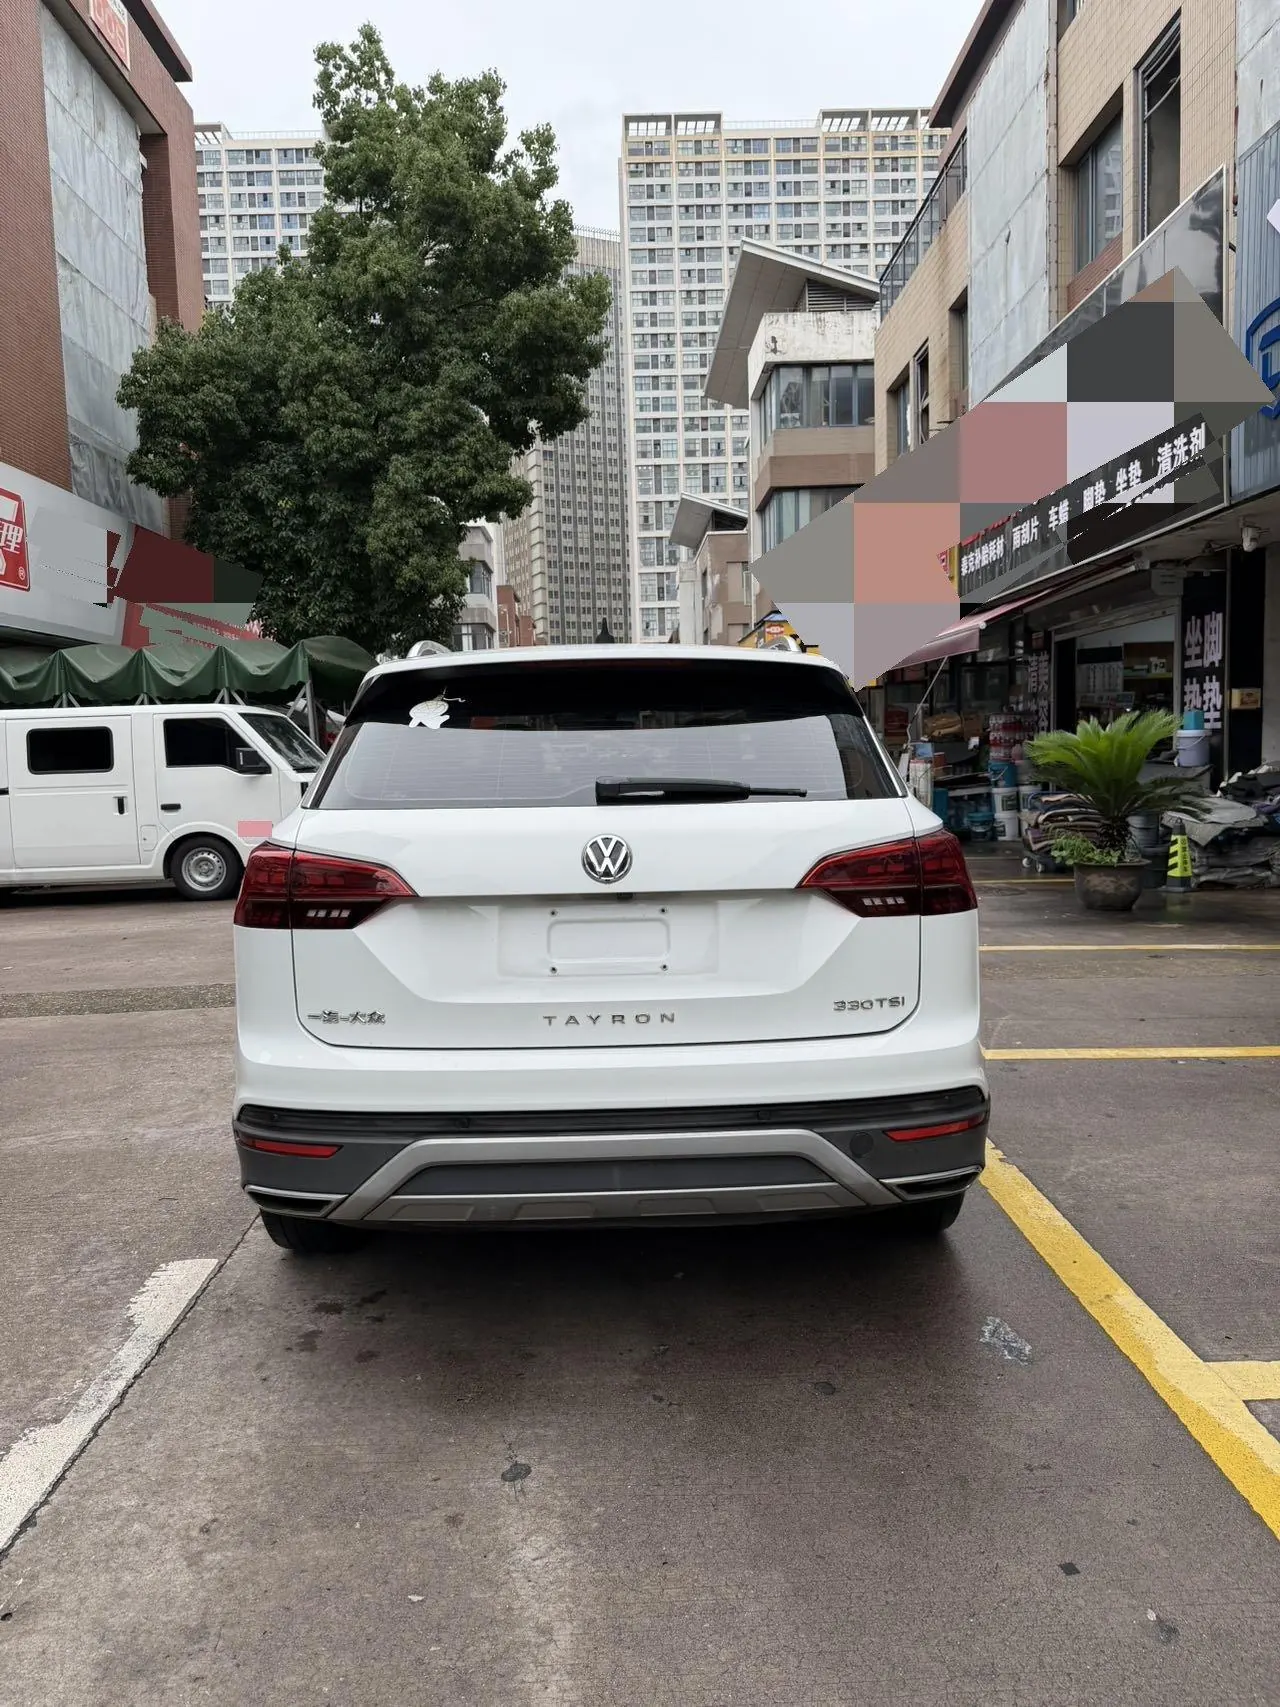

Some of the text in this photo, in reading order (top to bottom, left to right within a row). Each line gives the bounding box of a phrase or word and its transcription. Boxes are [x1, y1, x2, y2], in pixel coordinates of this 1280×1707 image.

[1012, 515, 1039, 551] 雨刮片
[1116, 459, 1142, 494] 坐垫
[1157, 422, 1206, 477] 清洗剂
[1203, 611, 1222, 729] 脚垫
[542, 1013, 676, 1026] TAYRON
[833, 996, 905, 1011] 330TSI
